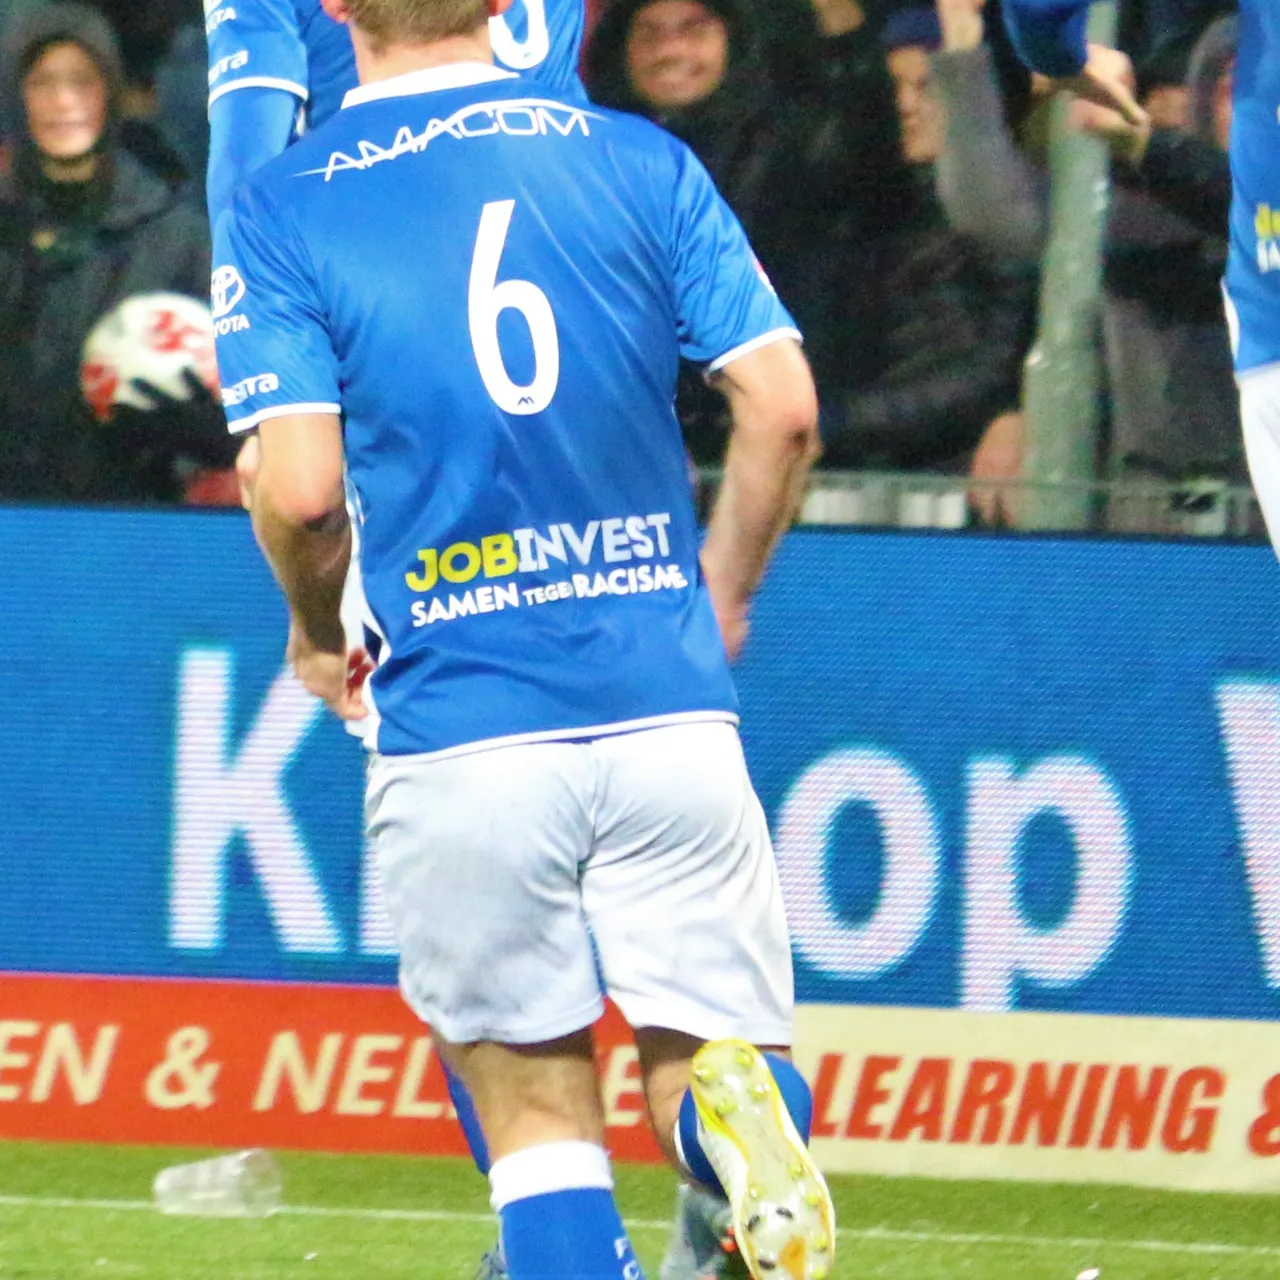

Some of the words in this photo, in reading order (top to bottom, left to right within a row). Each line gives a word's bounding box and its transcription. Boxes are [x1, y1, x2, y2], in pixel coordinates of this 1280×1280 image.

[468, 199, 560, 416] 6
[405, 512, 671, 593] JOBINVEST
[410, 582, 519, 628] SAMEN
[146, 1025, 220, 1111] &
[812, 1051, 1227, 1154] LEARNING
